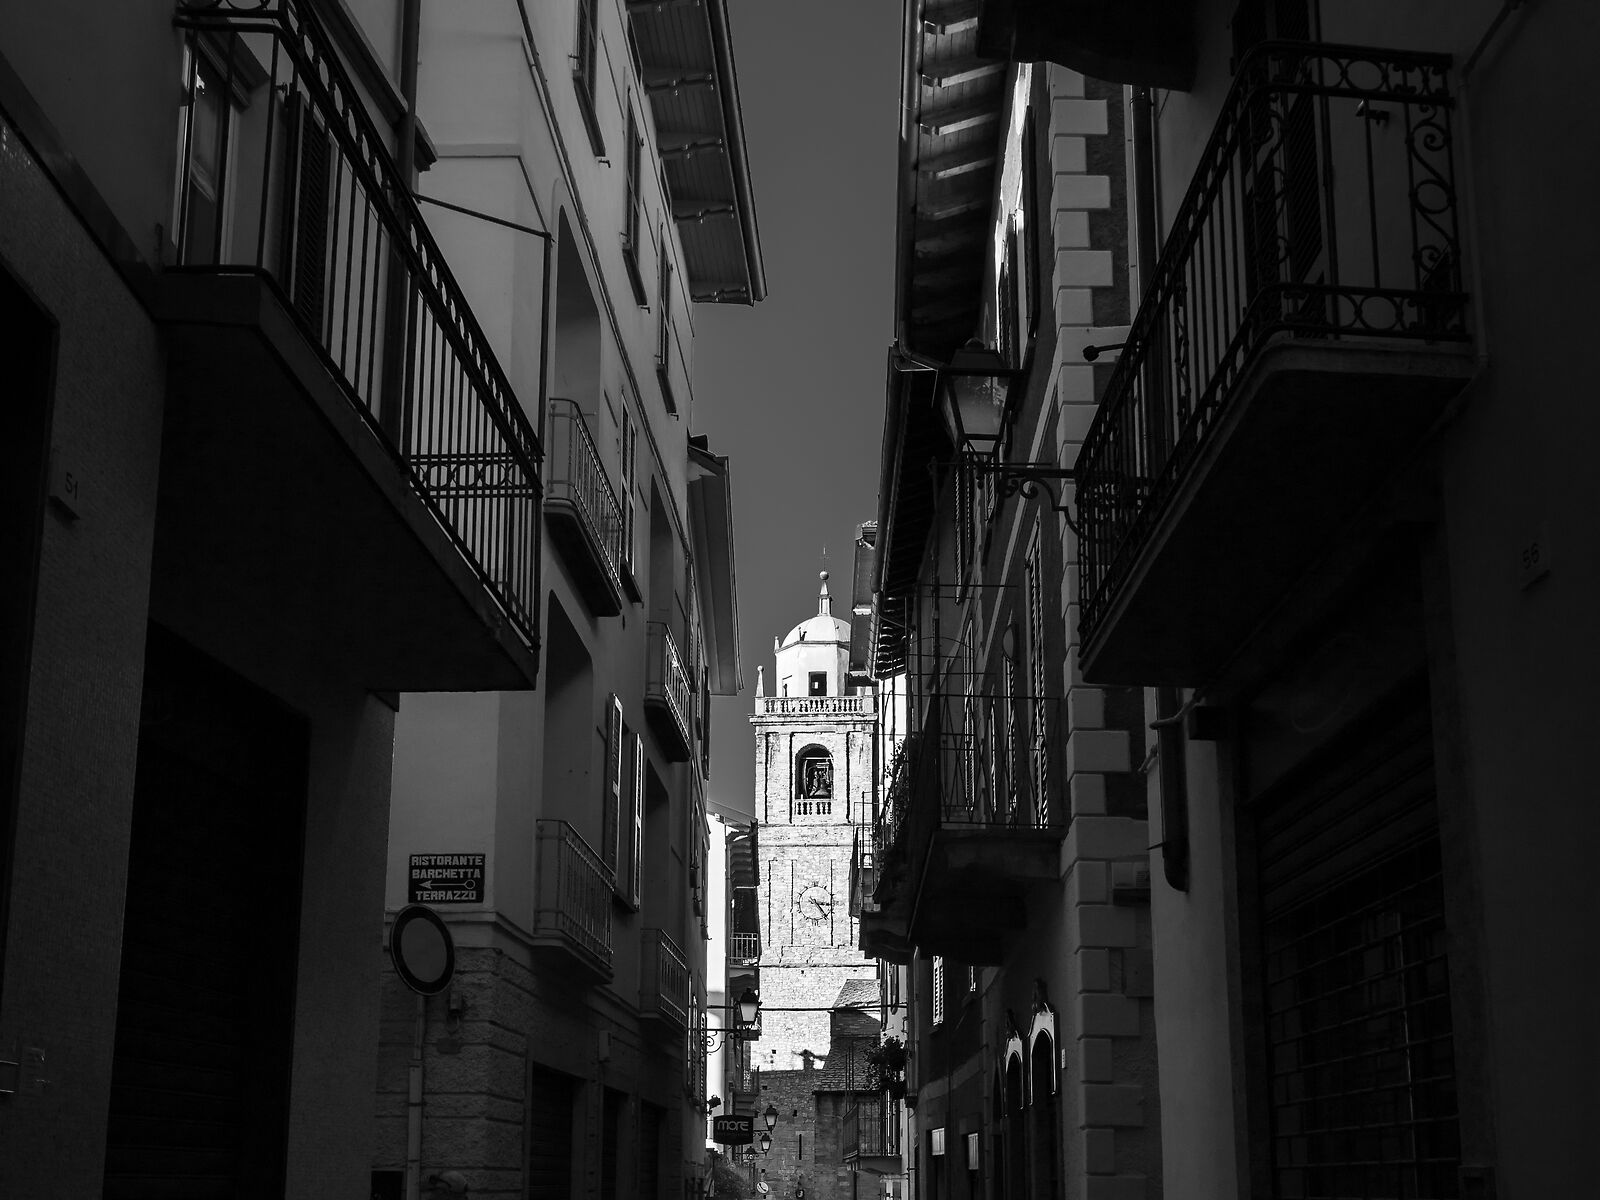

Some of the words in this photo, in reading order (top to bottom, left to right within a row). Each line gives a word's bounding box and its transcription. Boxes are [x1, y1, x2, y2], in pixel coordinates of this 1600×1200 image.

[65, 471, 78, 500] 51
[1522, 542, 1539, 569] 56
[411, 856, 483, 866] RISTORANTE
[412, 869, 481, 879] BARCHETTA
[416, 891, 477, 901] TERRAZZO
